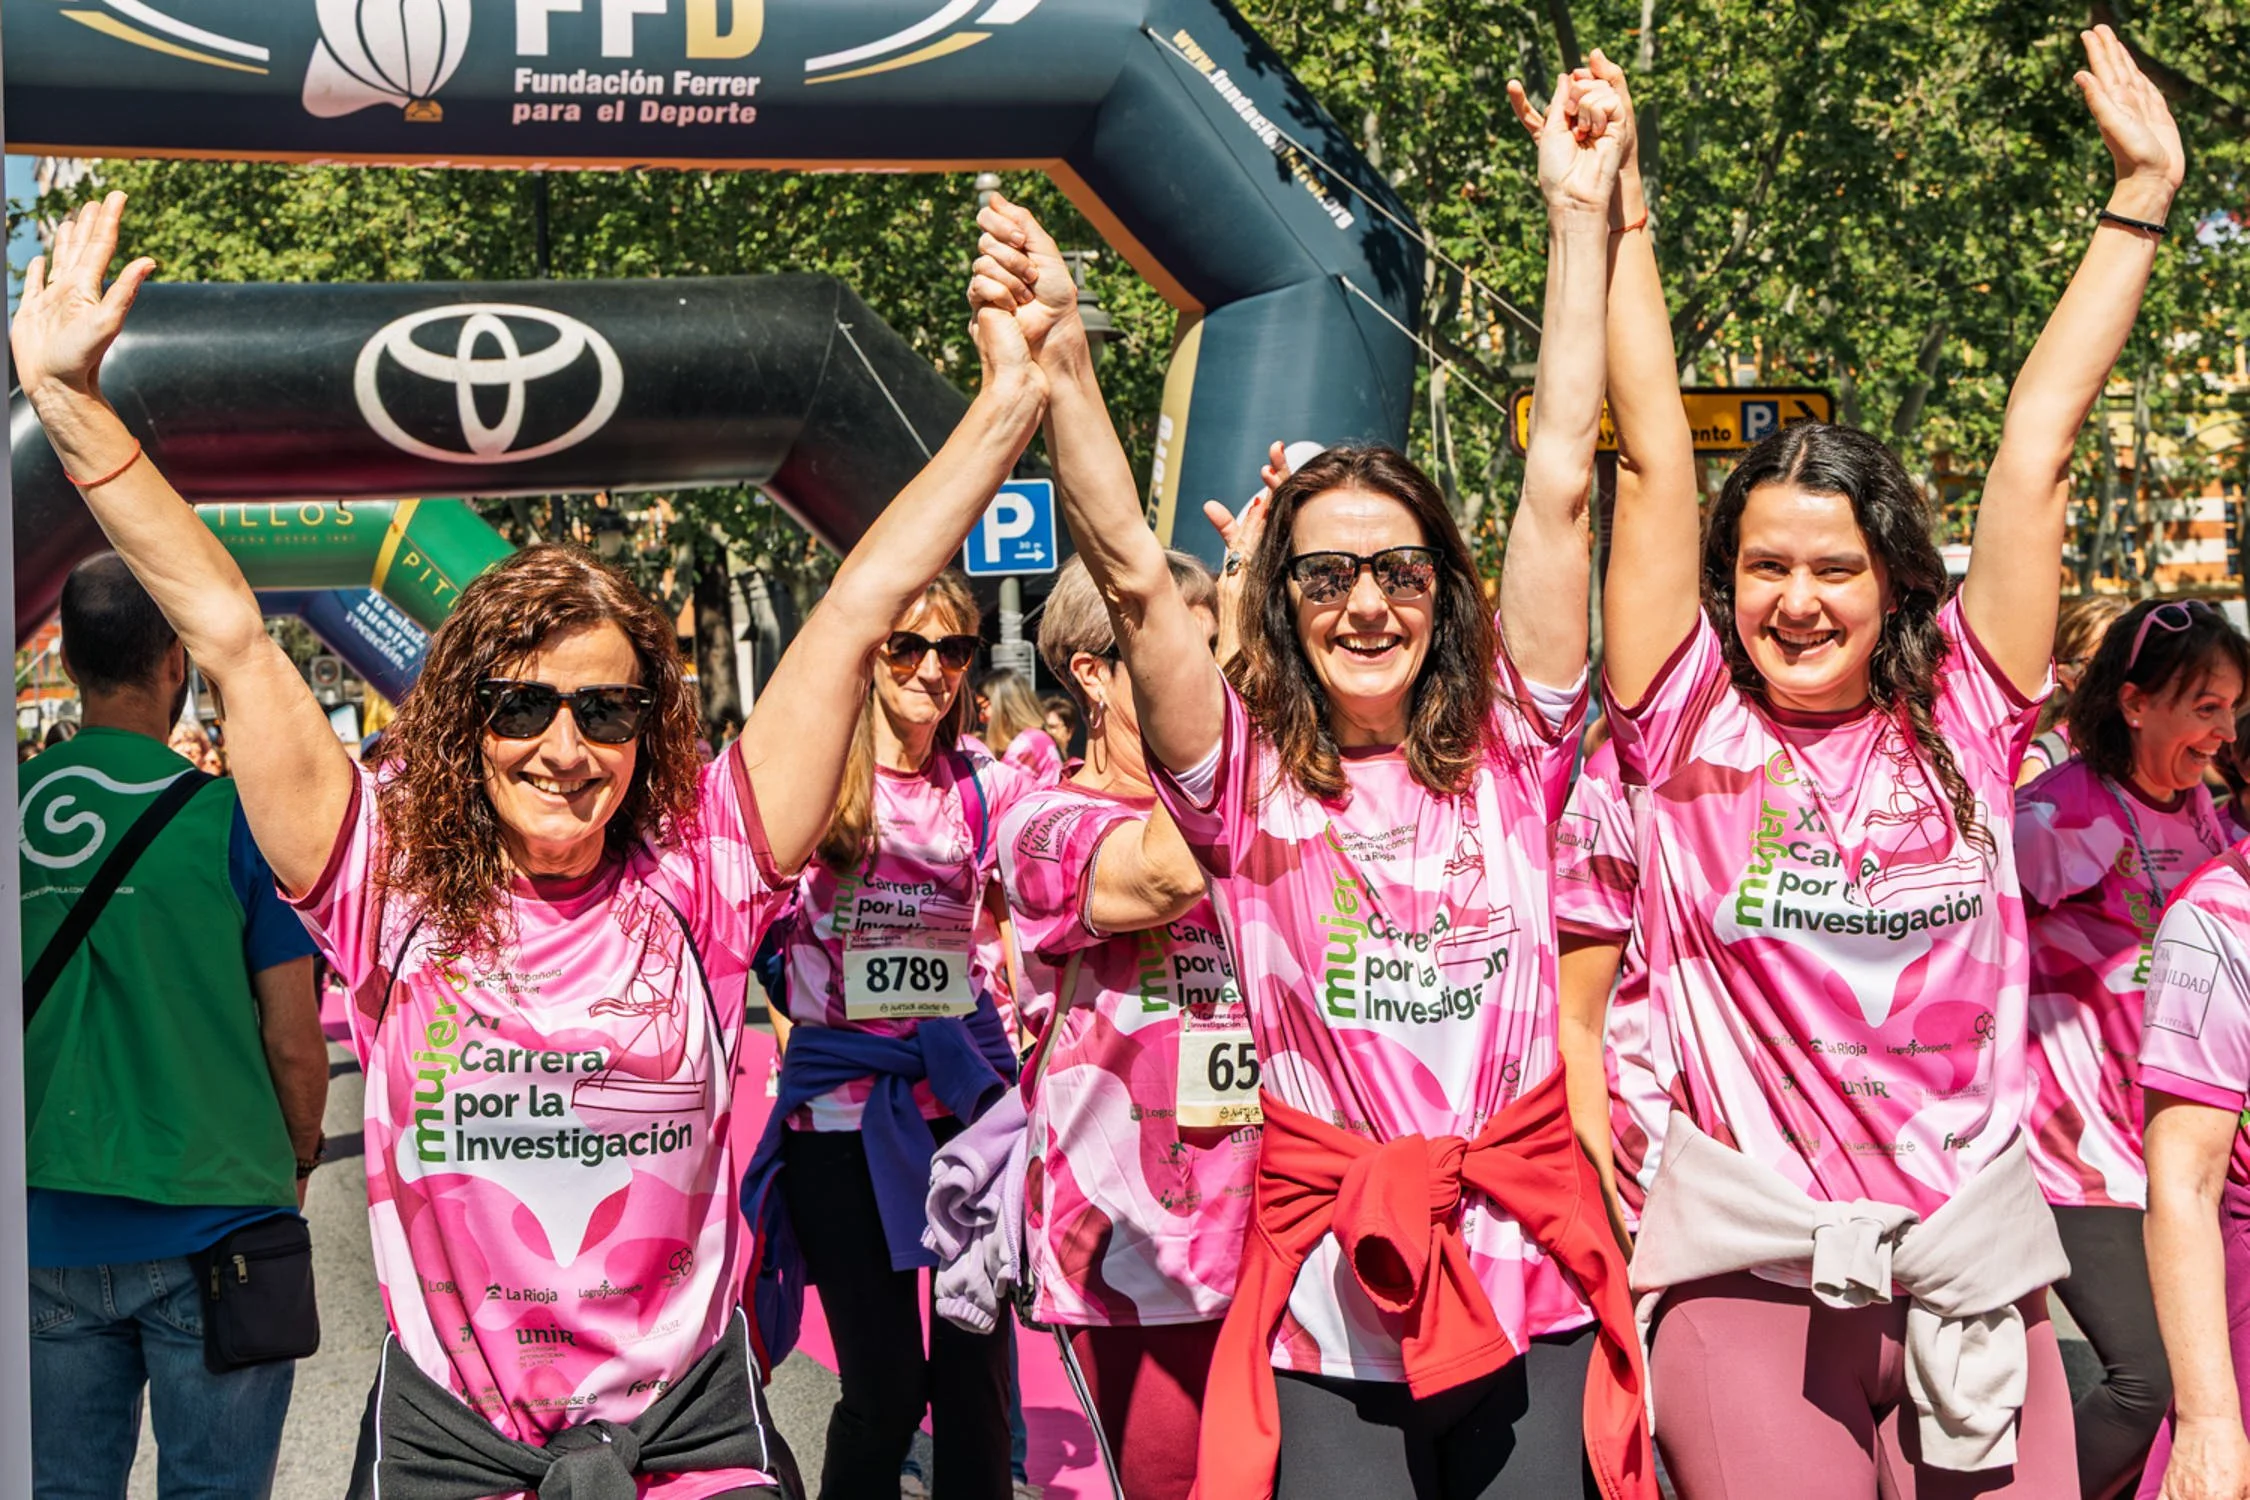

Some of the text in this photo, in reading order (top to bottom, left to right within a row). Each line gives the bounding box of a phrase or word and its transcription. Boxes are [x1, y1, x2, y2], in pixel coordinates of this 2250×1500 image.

[514, 67, 761, 96] Fundación Ferrer
[512, 100, 757, 127] para el Deporte
[218, 503, 354, 527] ILLOS
[401, 550, 455, 602] PIT
[356, 601, 417, 659] nuestra
[863, 872, 934, 896] Carrera
[1777, 871, 1838, 897] por
[857, 898, 916, 917] por la
[1773, 891, 1983, 941] Investigación
[1320, 869, 1369, 1019] mujer
[866, 956, 949, 993] 8789
[1173, 954, 1214, 979] por
[1365, 955, 1414, 987] por
[460, 1040, 606, 1073] Carrera
[1837, 1043, 1868, 1056] Rioja
[414, 997, 461, 1163] mujer
[1208, 1043, 1259, 1092] 65
[455, 1085, 564, 1125] por la
[456, 1120, 693, 1167] Investigación
[506, 1287, 558, 1304] La Rioja
